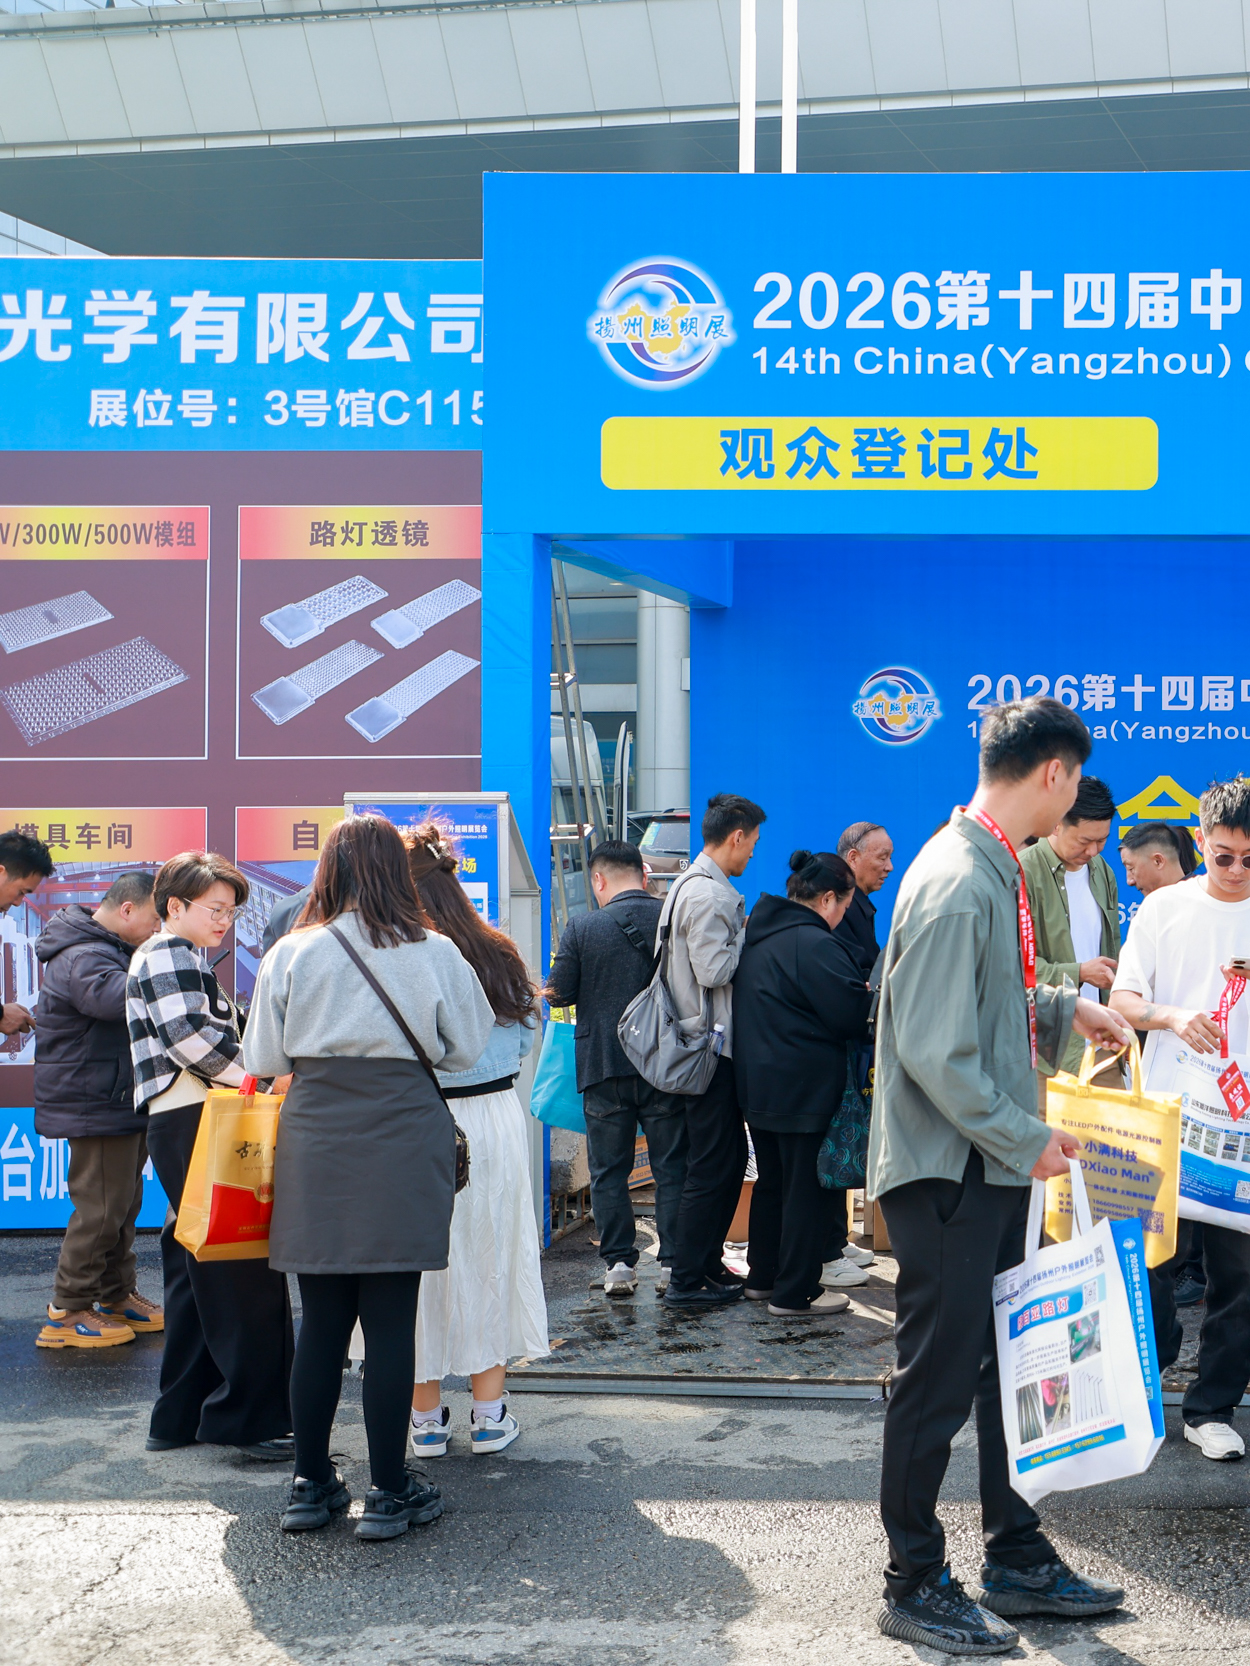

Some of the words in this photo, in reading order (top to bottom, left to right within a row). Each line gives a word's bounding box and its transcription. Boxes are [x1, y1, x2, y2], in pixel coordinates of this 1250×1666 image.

[0, 289, 483, 364] 光学有限公司
[753, 346, 840, 375] 14th
[853, 344, 1232, 380] China(Yangzhou)
[719, 426, 1039, 481] 观众登记处
[309, 520, 429, 547] 路灯透镜
[292, 820, 320, 851] 自
[1061, 1118, 1114, 1134] 专注LED户外配件
[1084, 1140, 1138, 1164] 小满科技
[1079, 1158, 1118, 1177] DXiao
